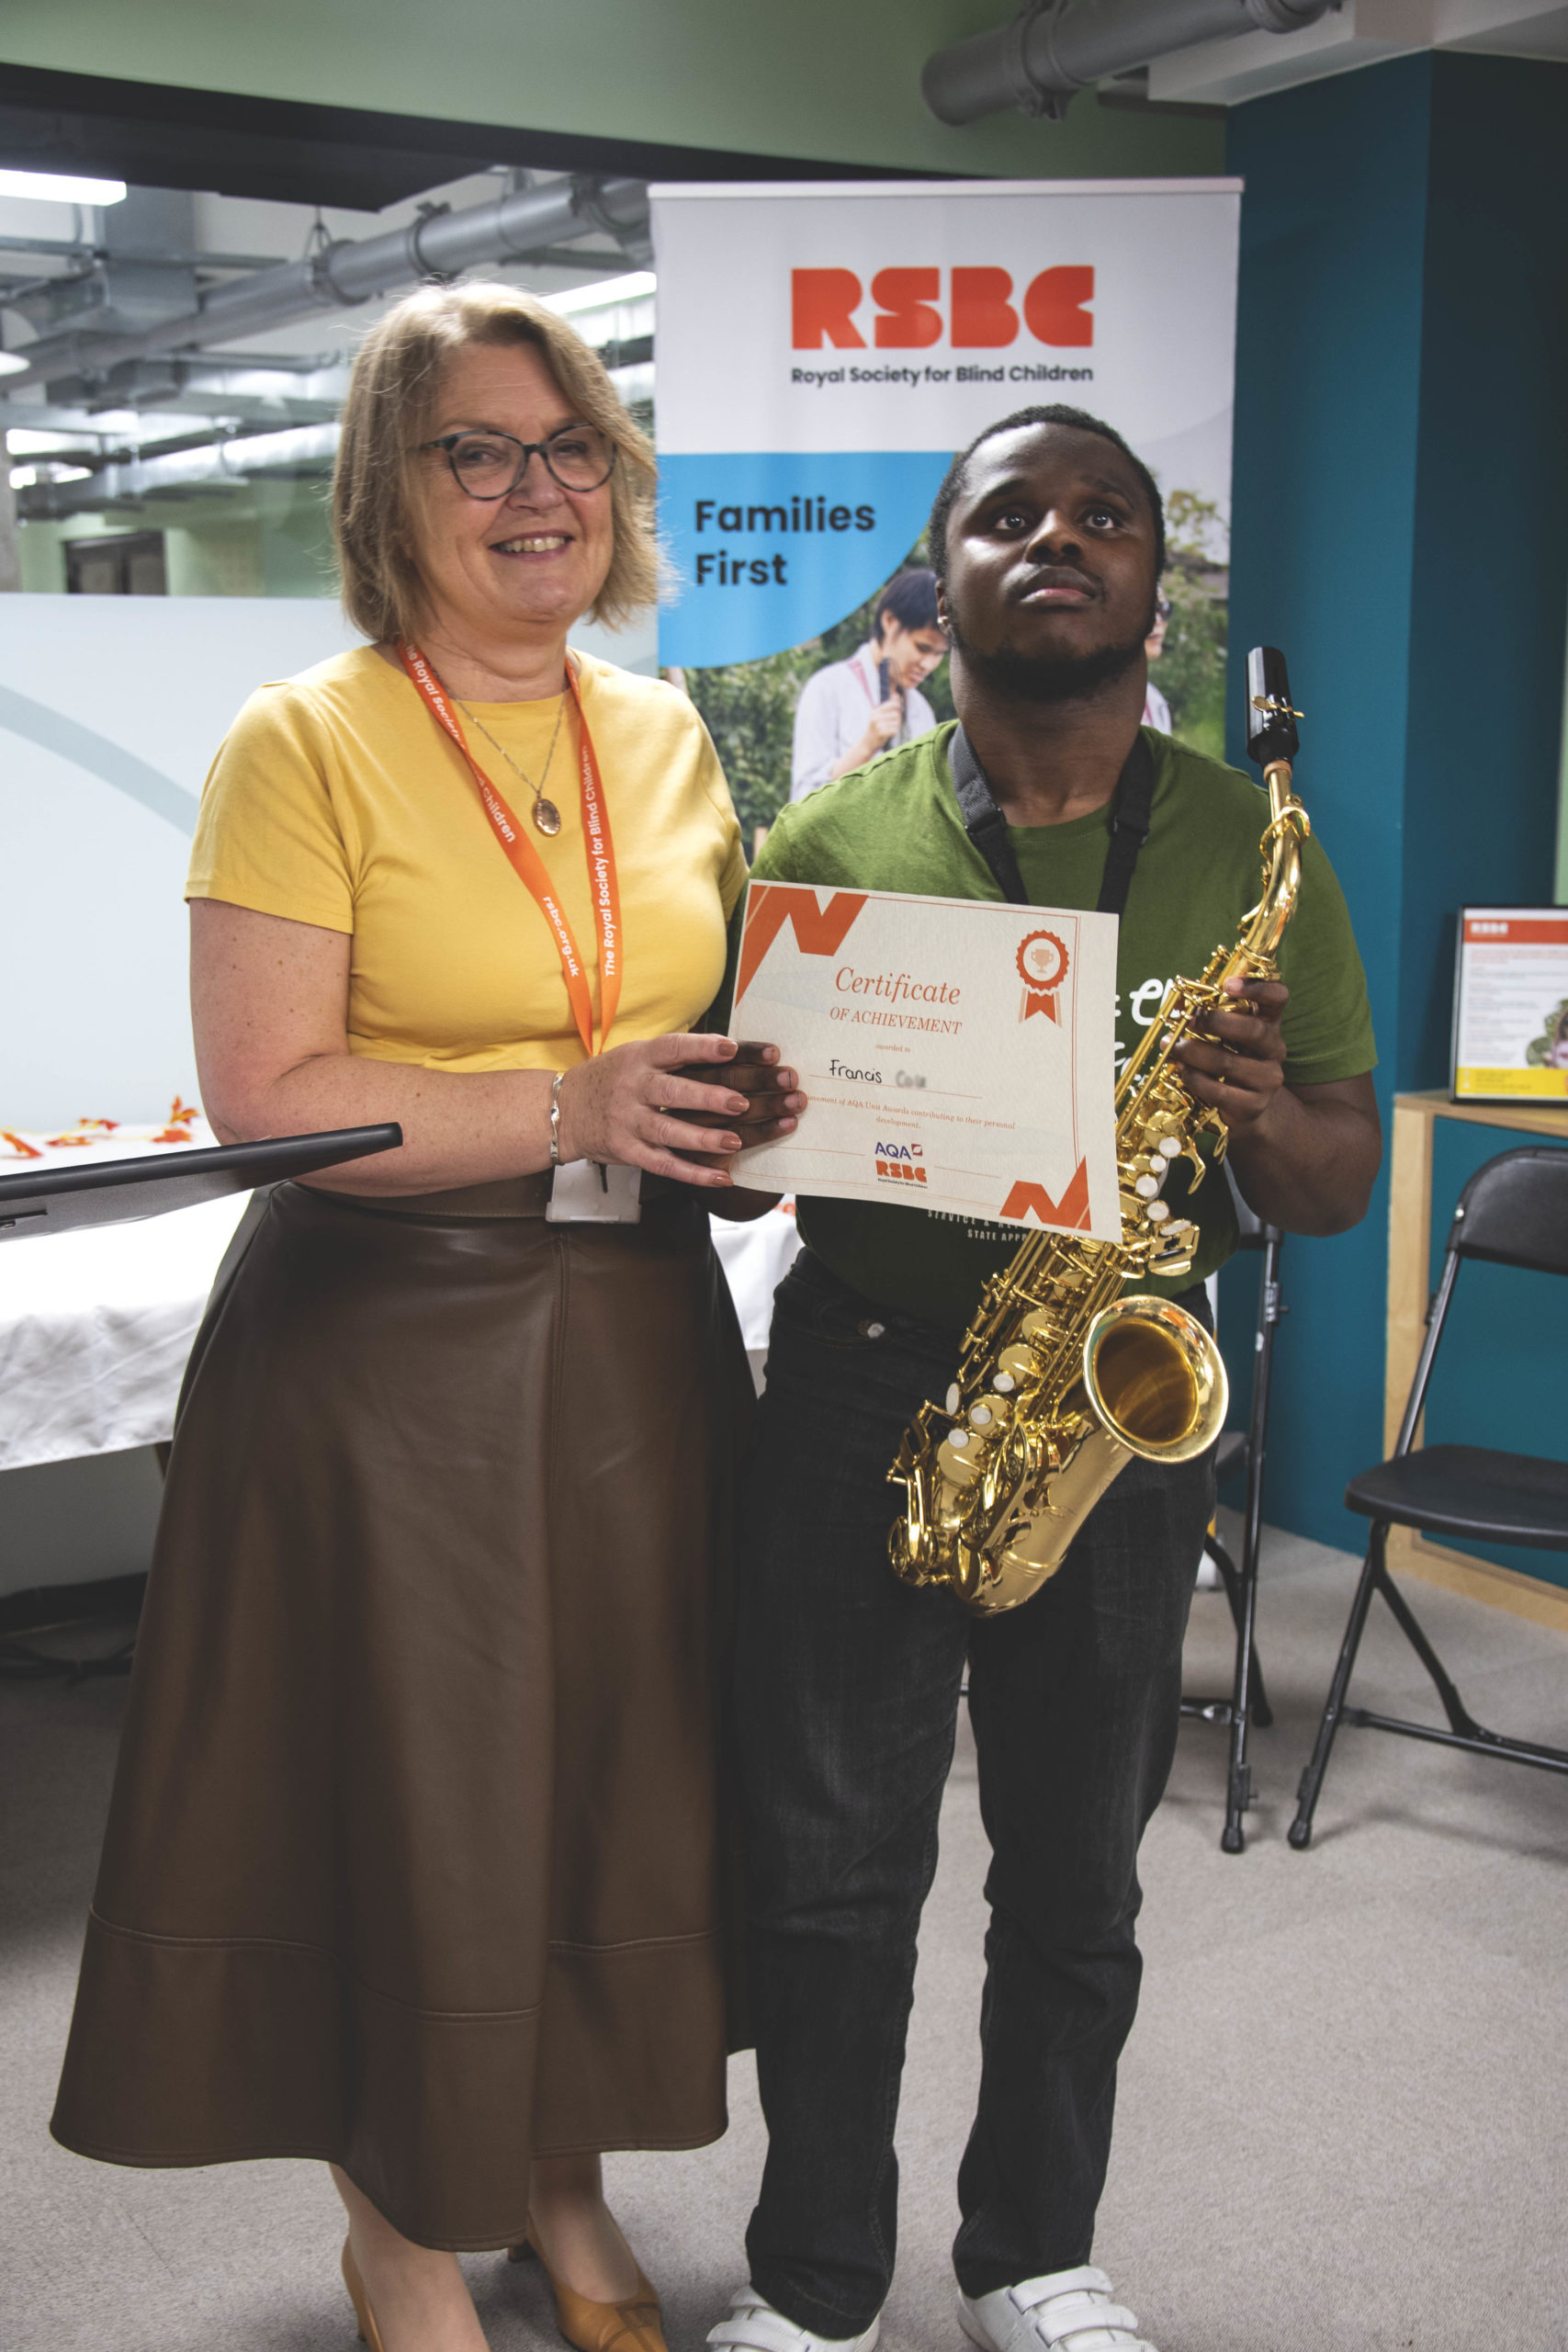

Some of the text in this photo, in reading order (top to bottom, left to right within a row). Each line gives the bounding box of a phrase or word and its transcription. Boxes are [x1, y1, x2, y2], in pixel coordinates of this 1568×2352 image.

[791, 266, 1095, 349] RSBC
[791, 365, 1093, 388] Royal Society for Blind Children
[695, 495, 875, 533] Families
[696, 550, 787, 585] First
[412, 660, 438, 695] Royal
[586, 801, 602, 835] Blind
[591, 837, 604, 855] for
[594, 856, 610, 906] Society
[543, 896, 580, 978] rsbc.org.uk
[601, 909, 616, 948] Royal
[604, 950, 615, 977] The
[835, 967, 961, 1005] Certificate
[829, 1006, 963, 1035] OF ACHIEVEMENT
[829, 1058, 883, 1084] Francis
[847, 1100, 863, 1109] AQA
[874, 1141, 912, 1160] AQA
[875, 1159, 927, 1183] RSBC
[967, 1228, 997, 1241] STATE
